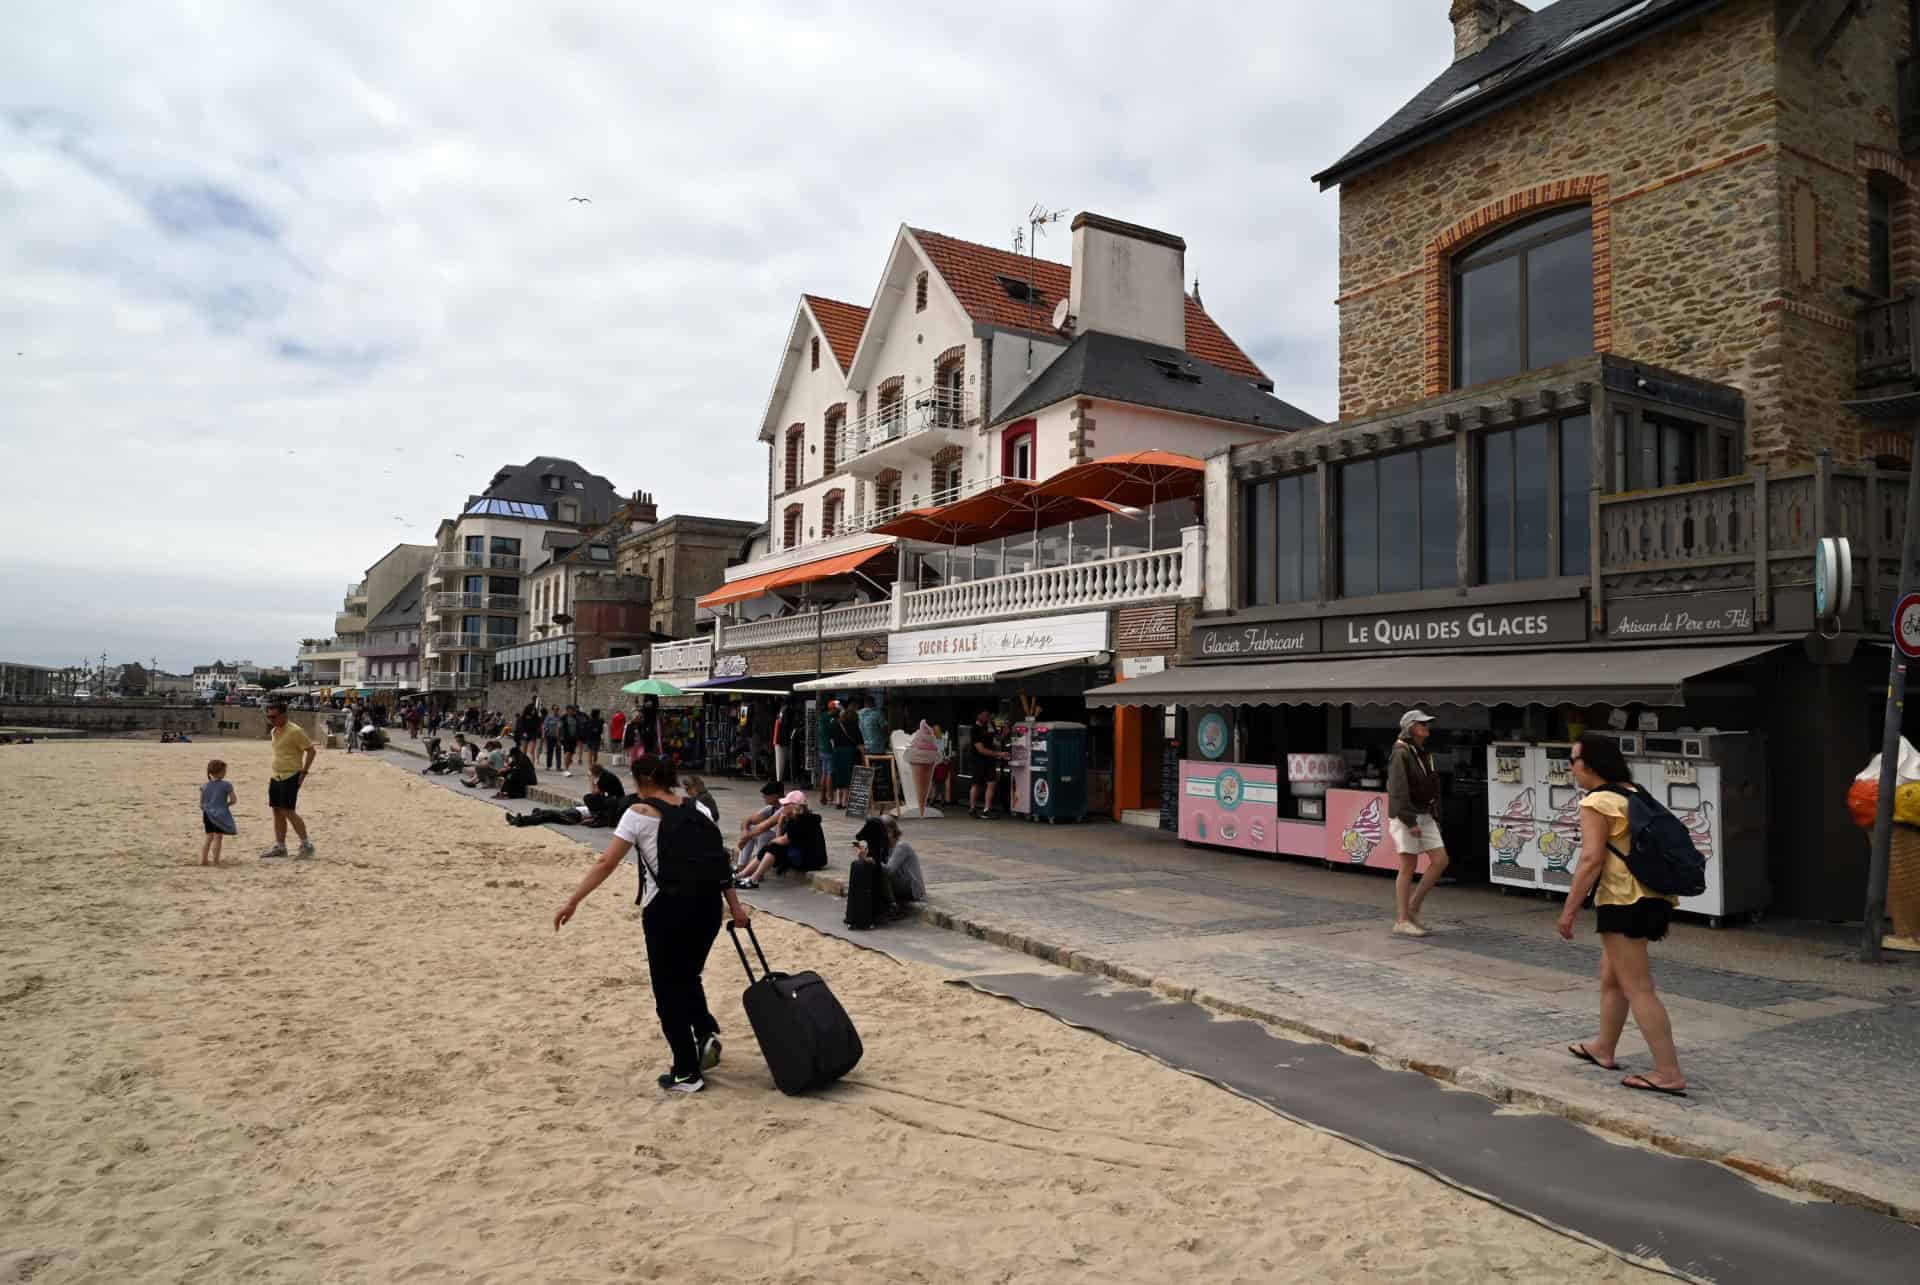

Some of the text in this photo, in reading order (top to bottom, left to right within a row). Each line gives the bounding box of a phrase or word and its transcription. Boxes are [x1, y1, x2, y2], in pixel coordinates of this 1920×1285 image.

[1610, 615, 1657, 634] Artisan
[1659, 613, 1673, 632] de
[1706, 618, 1721, 630] en
[918, 632, 978, 657] SUCRÉ SALÉ
[1202, 627, 1305, 654] Glacier Fabricant
